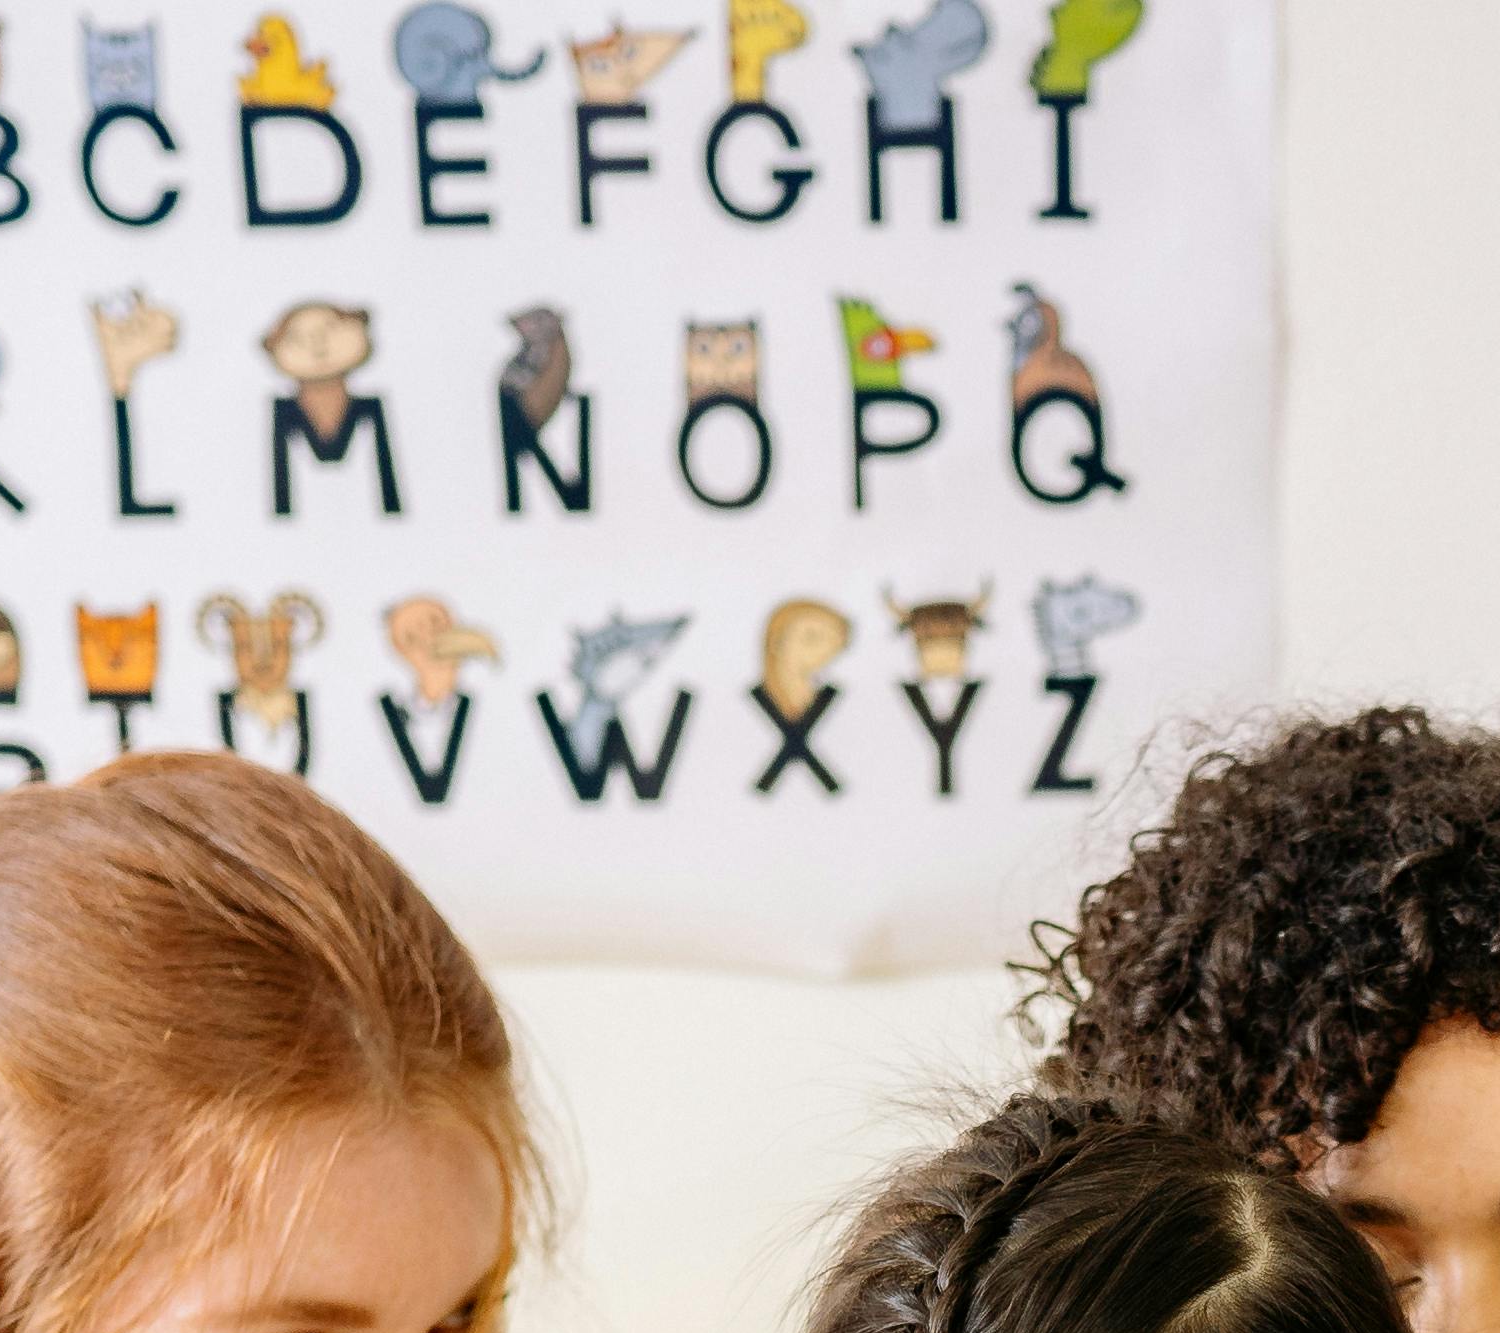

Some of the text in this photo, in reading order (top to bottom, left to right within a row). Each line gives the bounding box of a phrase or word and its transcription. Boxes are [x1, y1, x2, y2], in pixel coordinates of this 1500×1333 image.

[80, 102, 179, 226] C
[240, 104, 363, 227] D
[414, 102, 491, 227] E
[575, 103, 650, 226] F
[704, 101, 814, 224] G
[866, 96, 959, 223] H
[1037, 92, 1089, 220] I
[114, 397, 175, 516] L
[272, 395, 402, 516] M
[498, 392, 592, 513] N
[678, 392, 772, 510] O
[852, 386, 941, 510] P
[1011, 387, 1128, 505] Q
[379, 692, 471, 804] V
[535, 689, 693, 802] W
[749, 684, 841, 794] X
[901, 680, 983, 796] Y
[1032, 674, 1098, 792] Z
